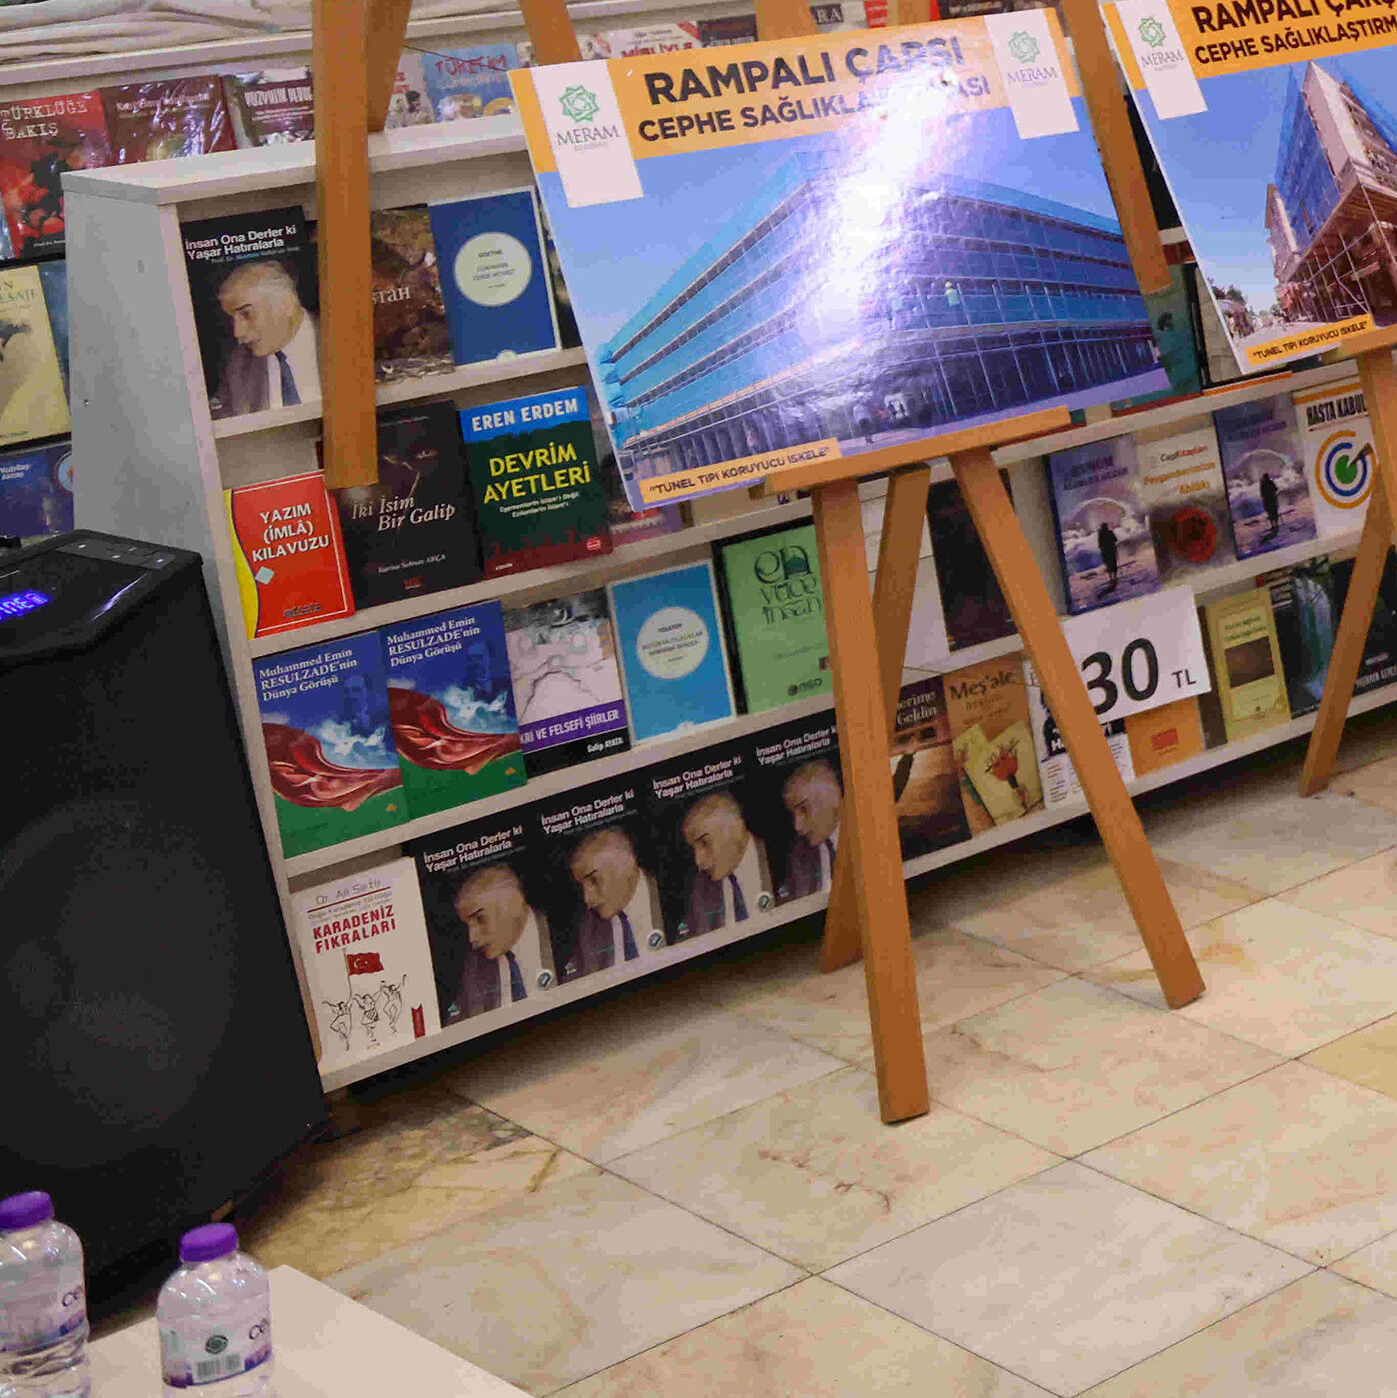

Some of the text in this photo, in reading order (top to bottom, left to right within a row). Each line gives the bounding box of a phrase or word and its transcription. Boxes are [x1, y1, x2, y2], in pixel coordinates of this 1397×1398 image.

[1140, 49, 1185, 70] MERAM
[1194, 36, 1260, 66] CEPHE
[644, 52, 835, 106] RAMPALI
[556, 124, 620, 147] MERAM
[638, 112, 736, 144] CEPHE
[186, 224, 297, 251] İnsan Ona Derler ki
[187, 246, 221, 262] Yaşar
[223, 236, 285, 255] Hatıralarla
[471, 399, 579, 433] EREN ERDEM
[488, 442, 578, 478] DEVRİM
[721, 459, 785, 480] KORUYUCU
[483, 462, 592, 504] AYETLERİ
[259, 502, 312, 525] YAZIM
[377, 503, 456, 532] Bir Galip
[262, 519, 314, 545] (İMLÂ)
[251, 533, 330, 563] KILAVUZU
[386, 615, 476, 646] Muhammed Emin
[388, 625, 481, 657] RESULZADE'nin
[259, 648, 353, 679] Muhammed Emin
[390, 640, 463, 668] Dünya Görüşü
[260, 658, 358, 691] RESULZADE'nin
[262, 673, 340, 703] Dünya Görüşü
[1080, 637, 1197, 716] 30 TL
[535, 726, 548, 740] VE
[312, 903, 395, 941] KARADENİZ
[315, 916, 398, 954] FIKRALARI
